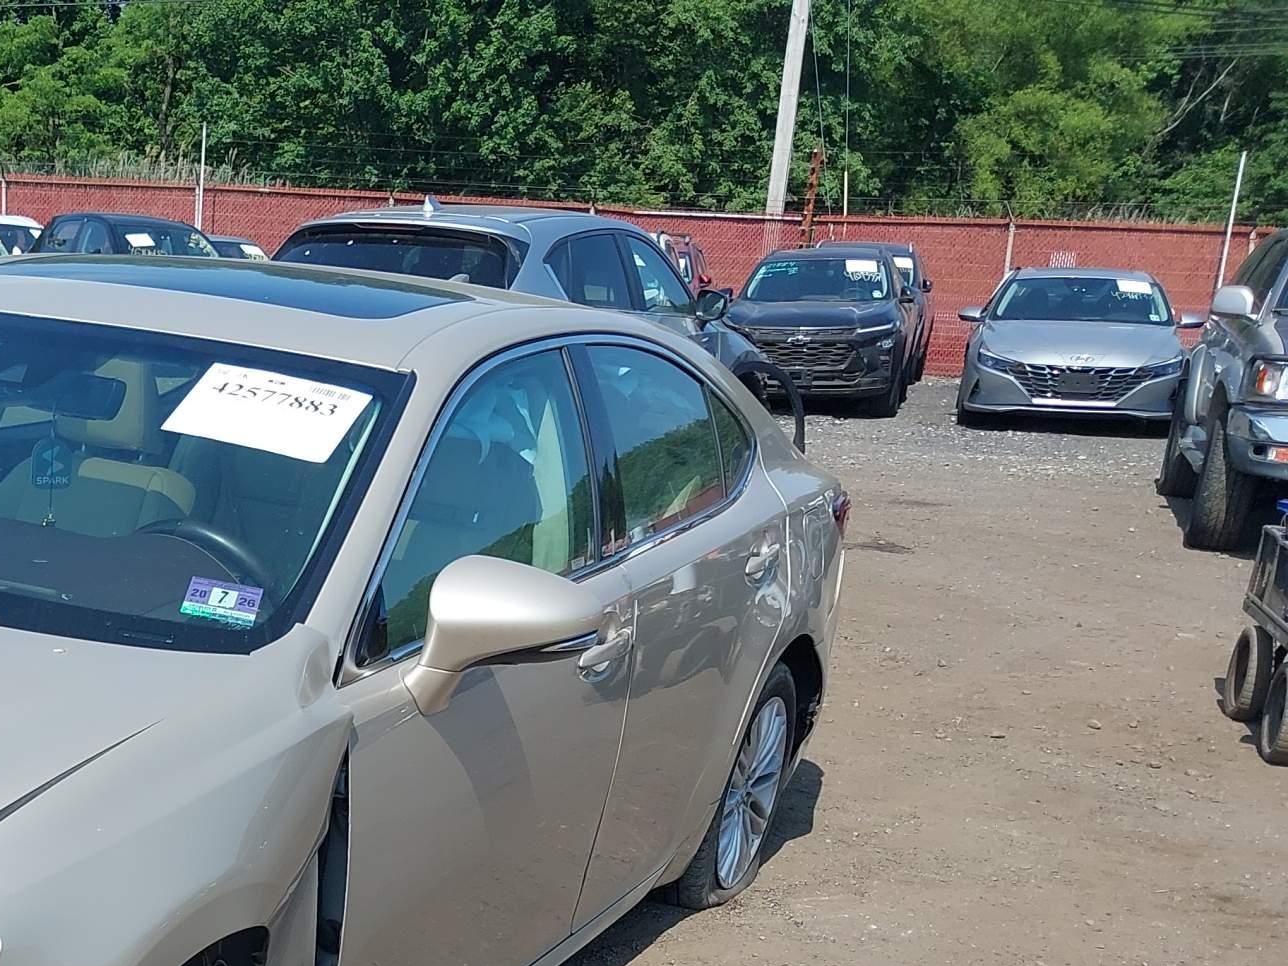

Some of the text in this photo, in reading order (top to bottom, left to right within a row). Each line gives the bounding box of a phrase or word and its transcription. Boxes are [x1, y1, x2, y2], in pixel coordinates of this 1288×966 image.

[212, 381, 339, 417] 42577883
[35, 476, 70, 485] SPARK
[190, 588, 256, 608] 20 7 26
